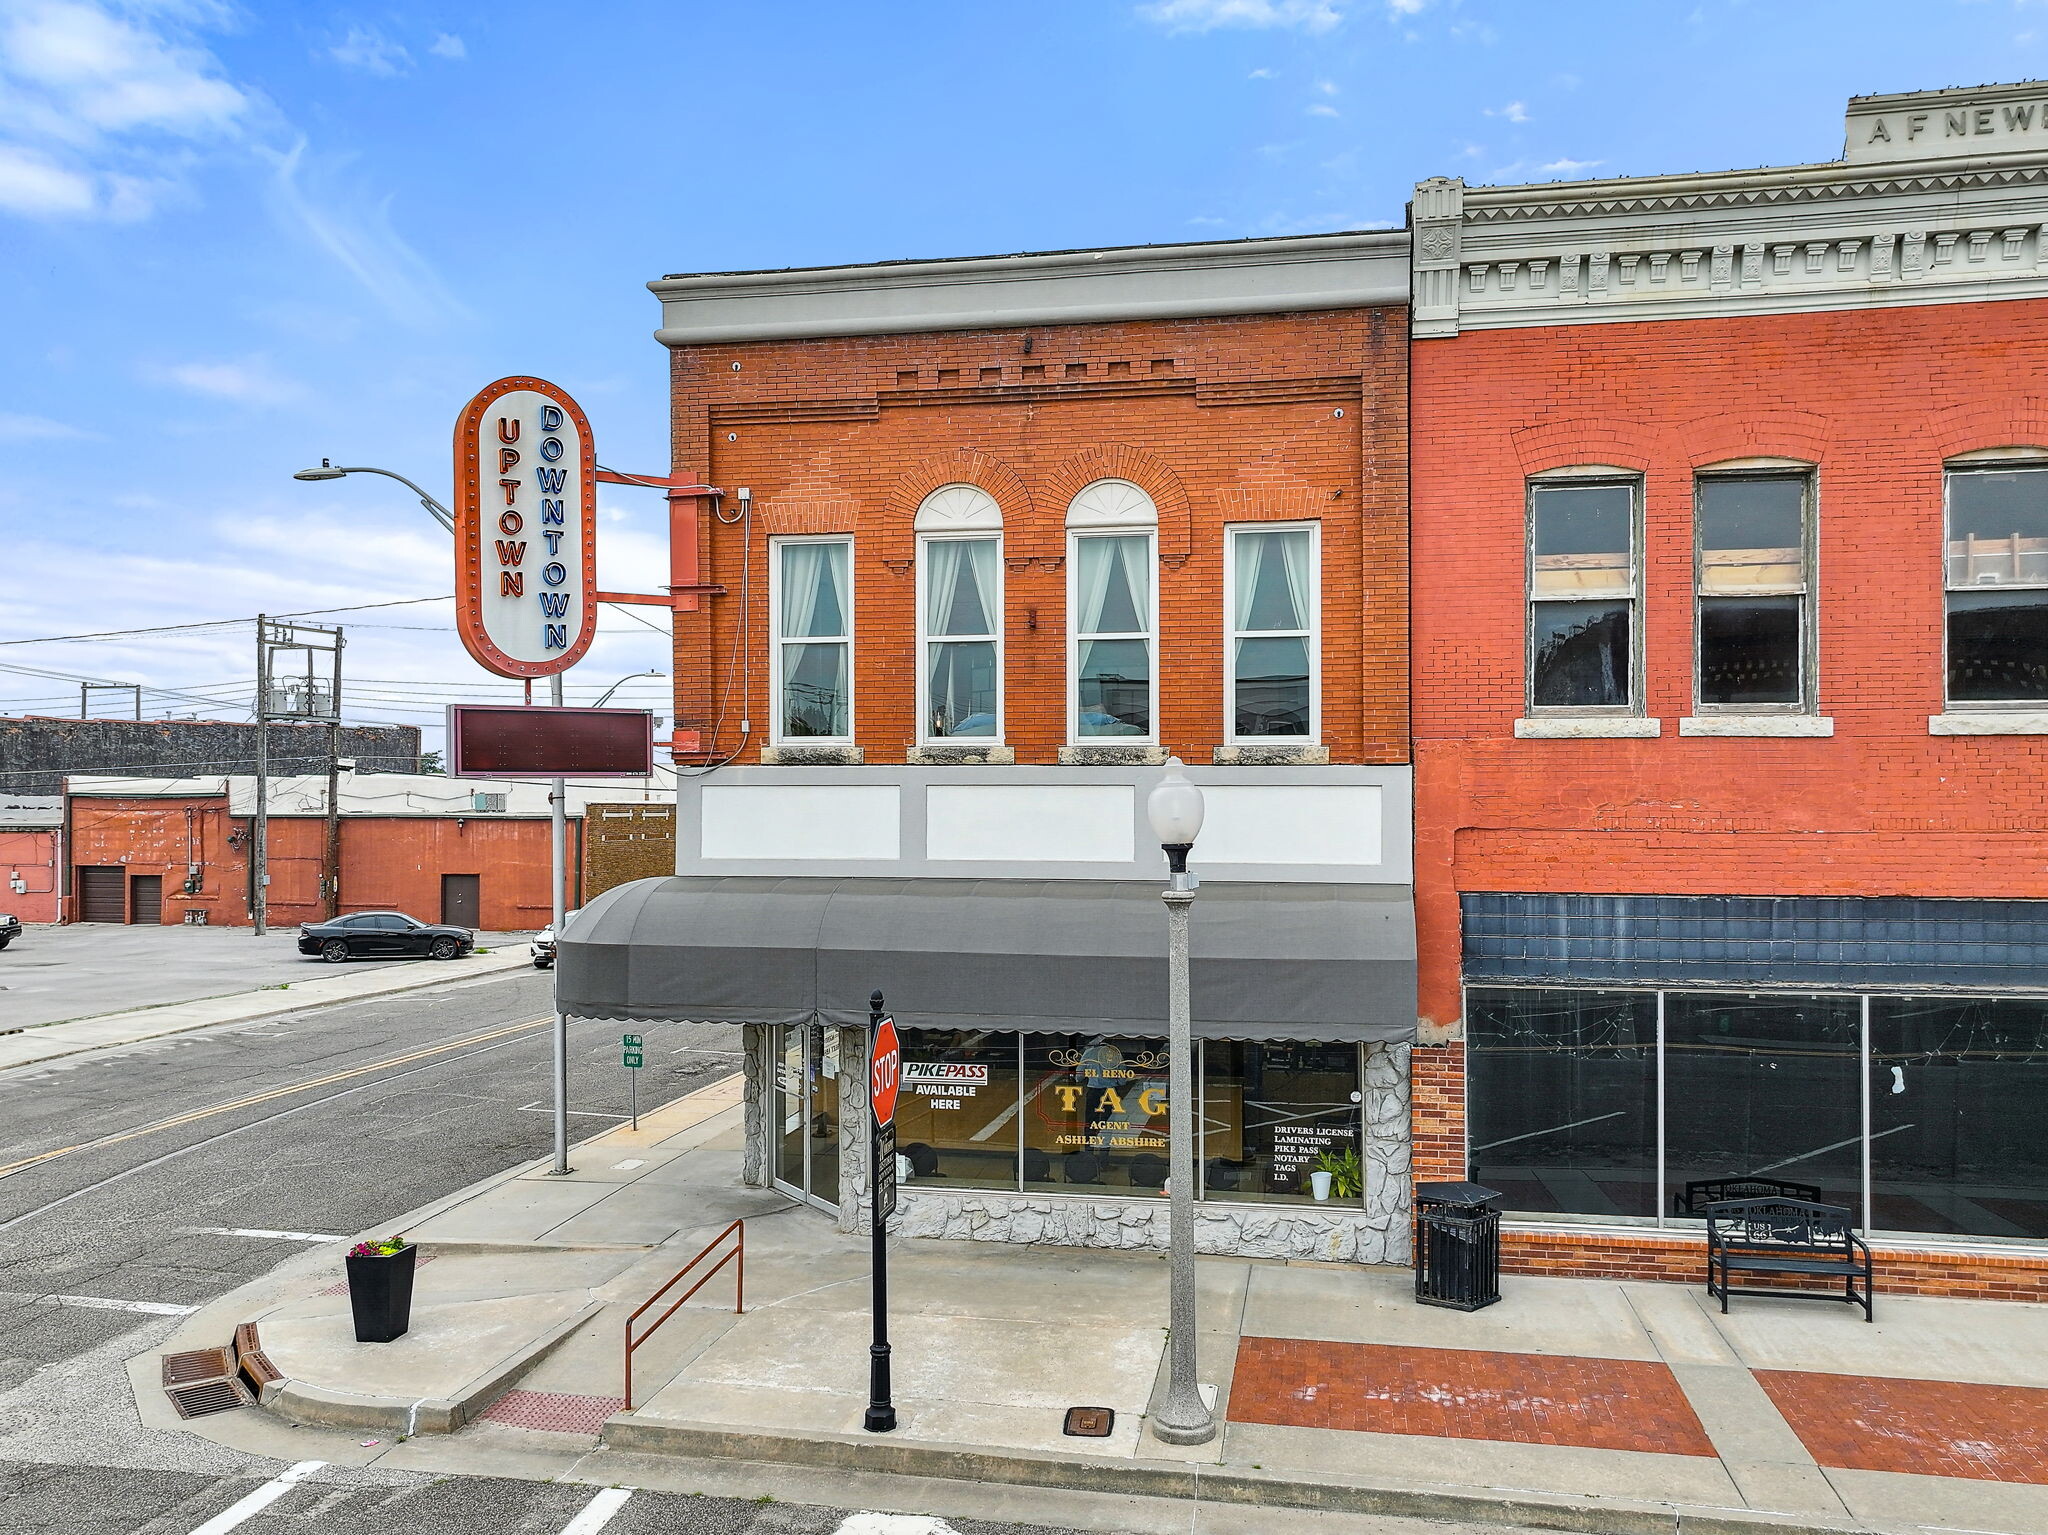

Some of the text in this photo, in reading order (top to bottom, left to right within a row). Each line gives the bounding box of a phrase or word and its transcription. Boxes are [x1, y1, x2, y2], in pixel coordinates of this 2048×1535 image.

[1868, 118, 1891, 144] A
[1907, 114, 1928, 140] F
[495, 417, 528, 598] UPTOWN
[536, 405, 570, 649] DOWNTOWN
[623, 1045, 643, 1055] PARKING
[627, 1056, 639, 1065] ONLY
[874, 1049, 898, 1097] STOP
[906, 1063, 987, 1079] PIKEPASS
[1084, 1068, 1135, 1079] EL RENO
[915, 1084, 976, 1097] AVAILABLE
[930, 1098, 960, 1110] HERE
[1055, 1085, 1168, 1117] TAG
[1089, 1120, 1131, 1130] AGENT
[1274, 1126, 1354, 1137] DRIVERS LICENSE
[1055, 1134, 1166, 1147] ASHLEY ABSHIRE
[1274, 1136, 1332, 1145] LAMINATING
[1274, 1145, 1319, 1155] PIKE PASS
[1274, 1155, 1310, 1163] NOTARY
[1274, 1164, 1296, 1172] TAGS
[1274, 1173, 1289, 1181] I.D.
[1748, 1205, 1807, 1217] OKLAHOMA
[1753, 1222, 1766, 1231] US
